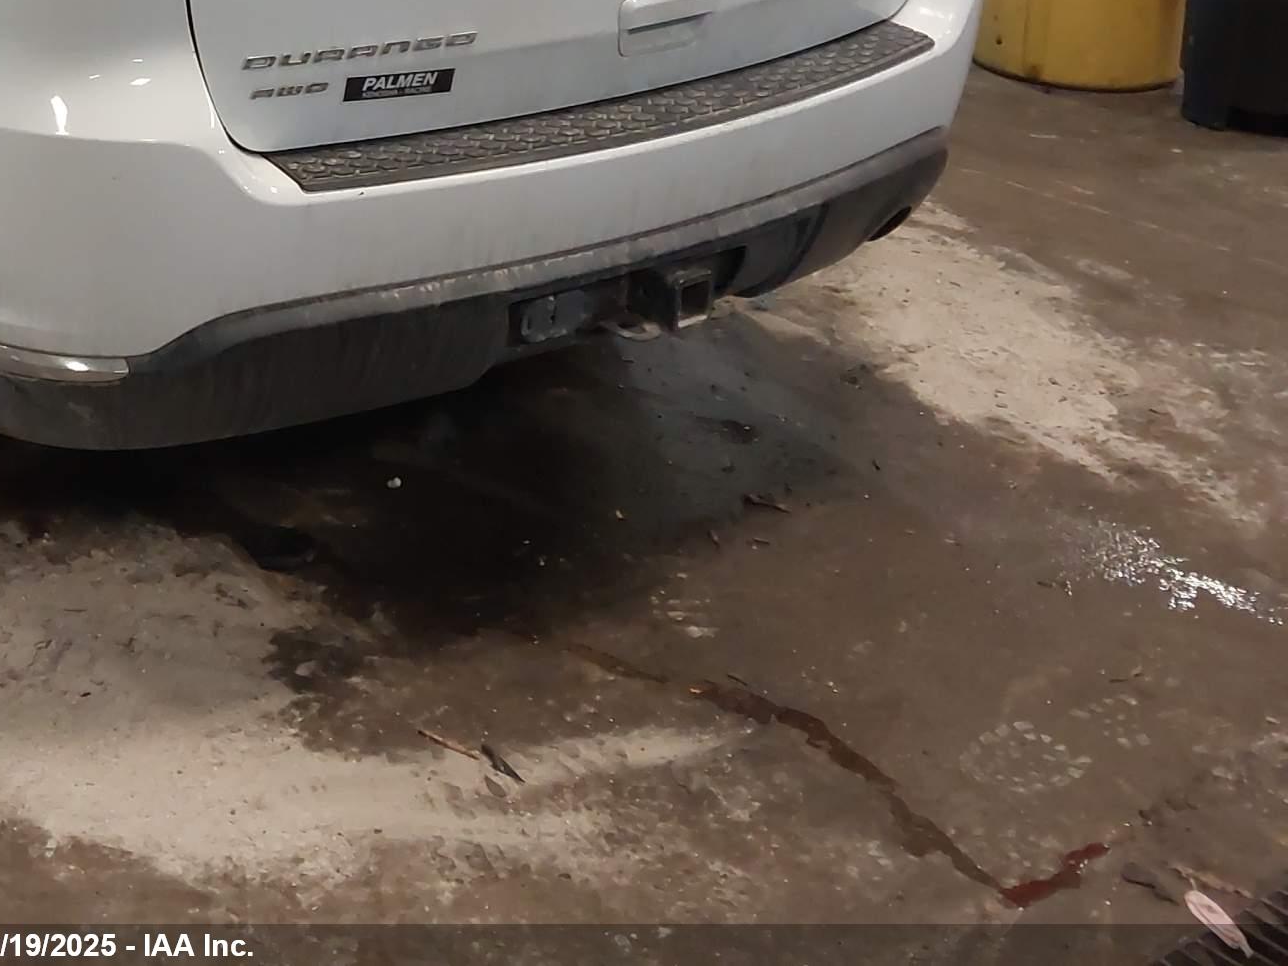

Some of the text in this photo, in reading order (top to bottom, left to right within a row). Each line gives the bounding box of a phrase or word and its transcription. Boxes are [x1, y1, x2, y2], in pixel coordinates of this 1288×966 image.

[241, 30, 479, 70] DURANGO
[249, 82, 329, 100] AWD
[361, 71, 439, 92] PALMEN
